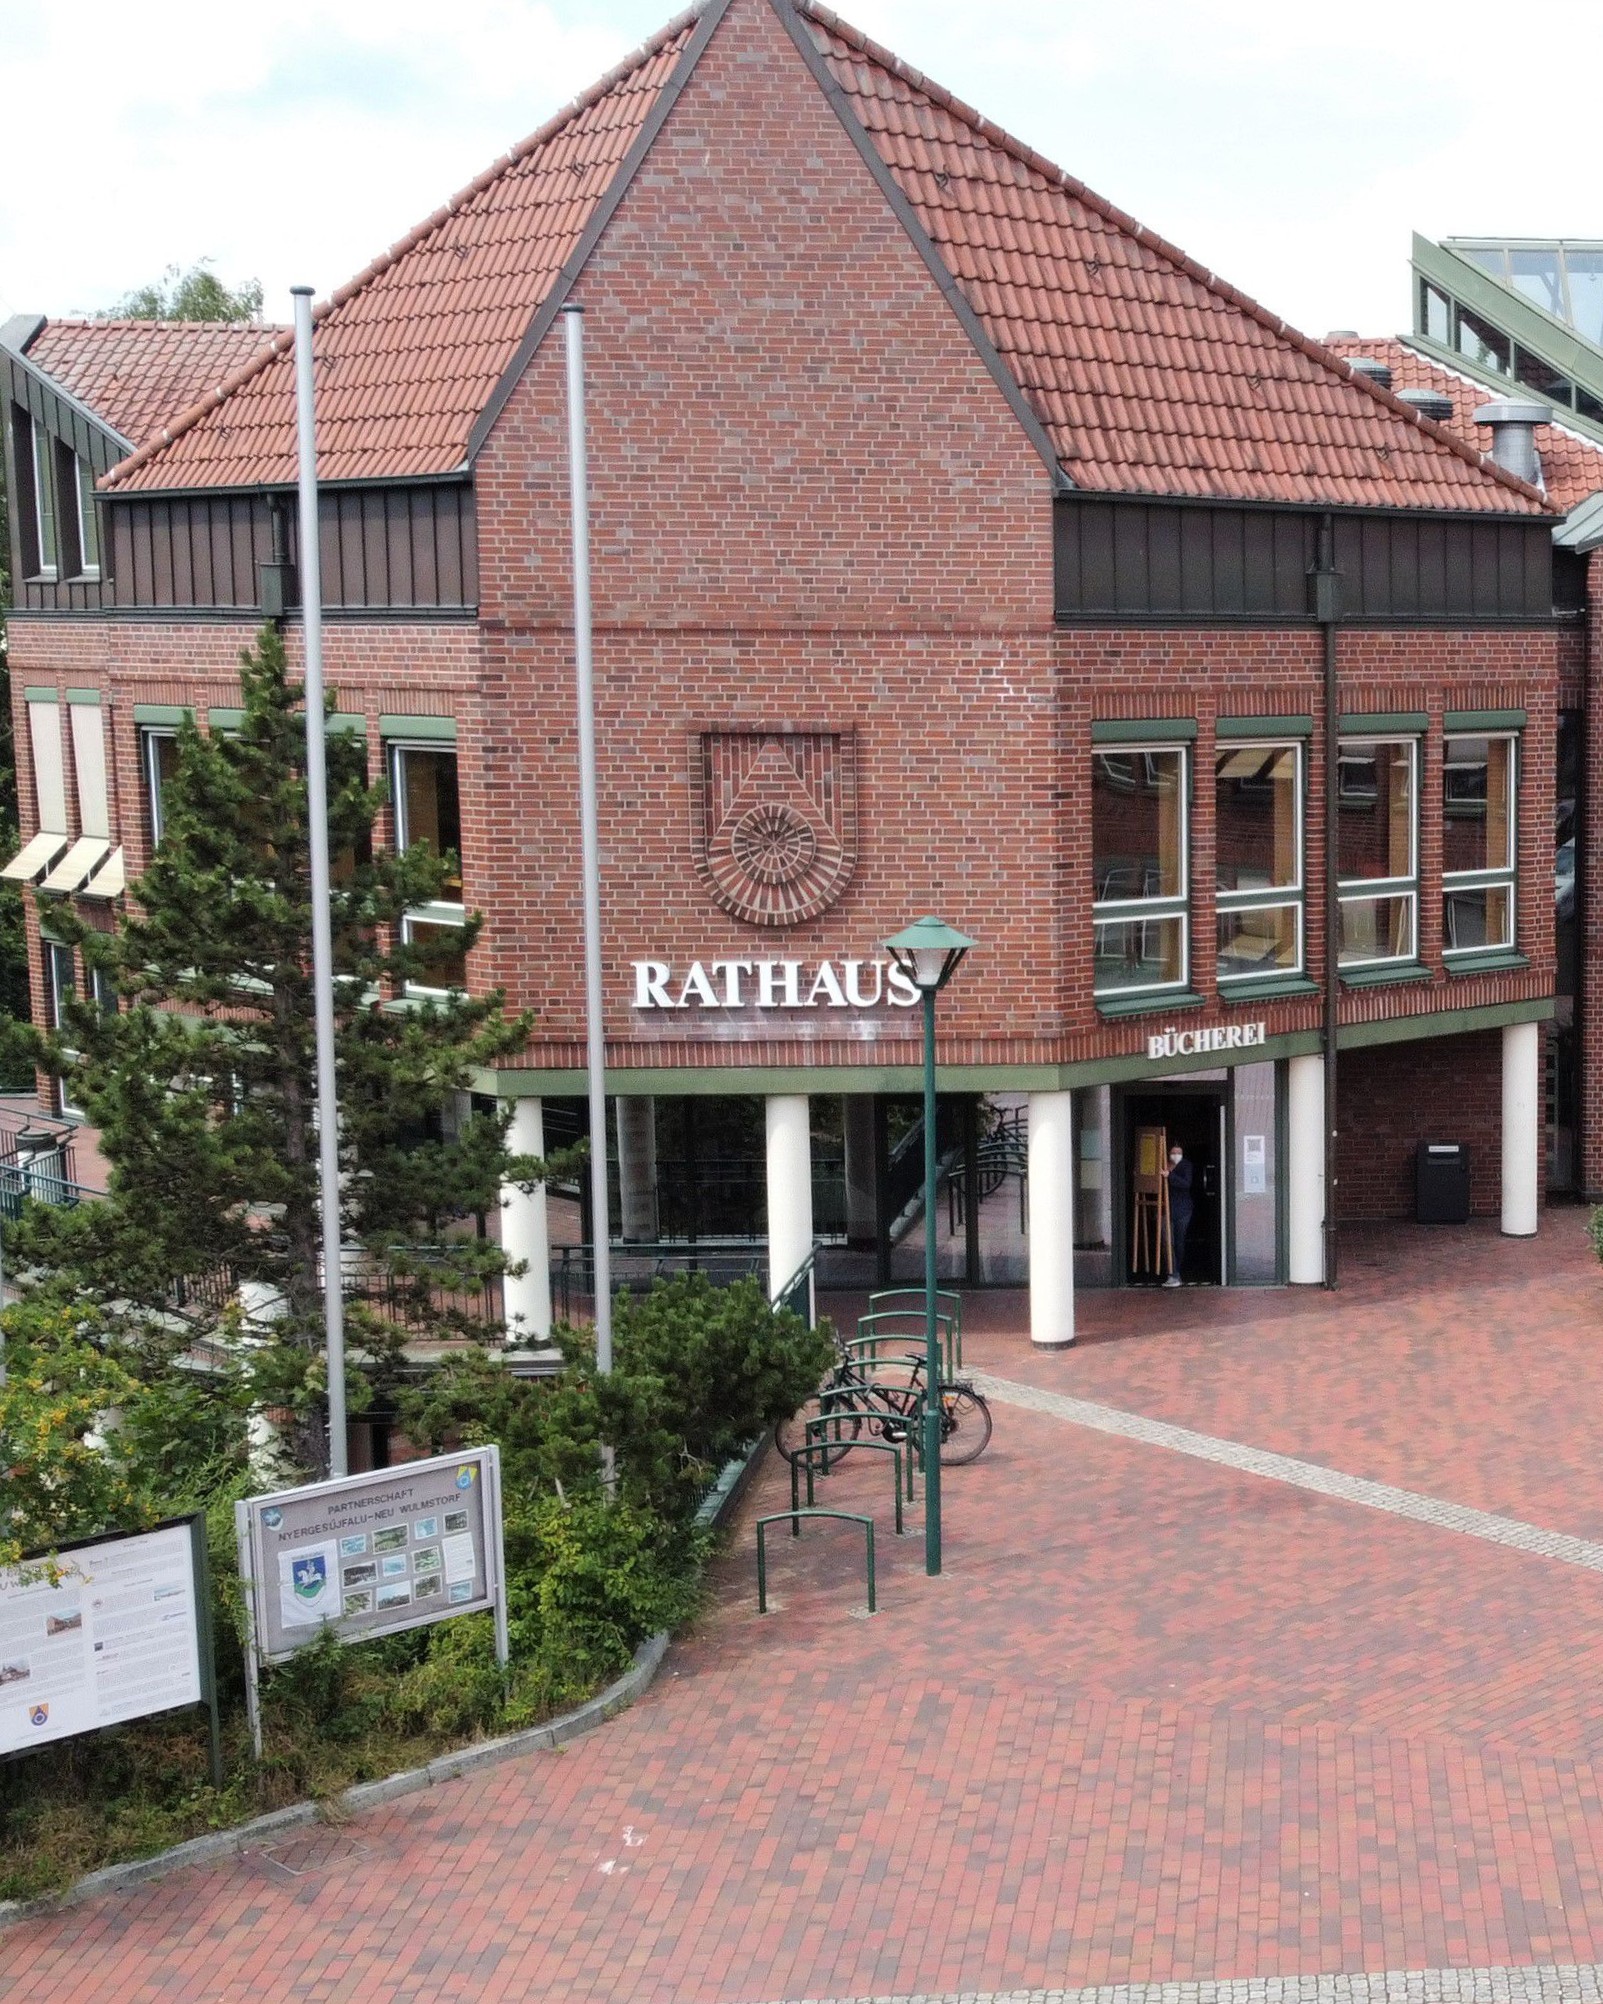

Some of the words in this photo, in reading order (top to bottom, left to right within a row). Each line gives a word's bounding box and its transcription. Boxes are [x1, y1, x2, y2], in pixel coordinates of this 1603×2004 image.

[630, 960, 922, 1008] RATHAUS
[1147, 1022, 1266, 1060] BÜCHEREI
[328, 1488, 414, 1515] PARTNERSCHAFT
[400, 1493, 462, 1514] WULMSTORF
